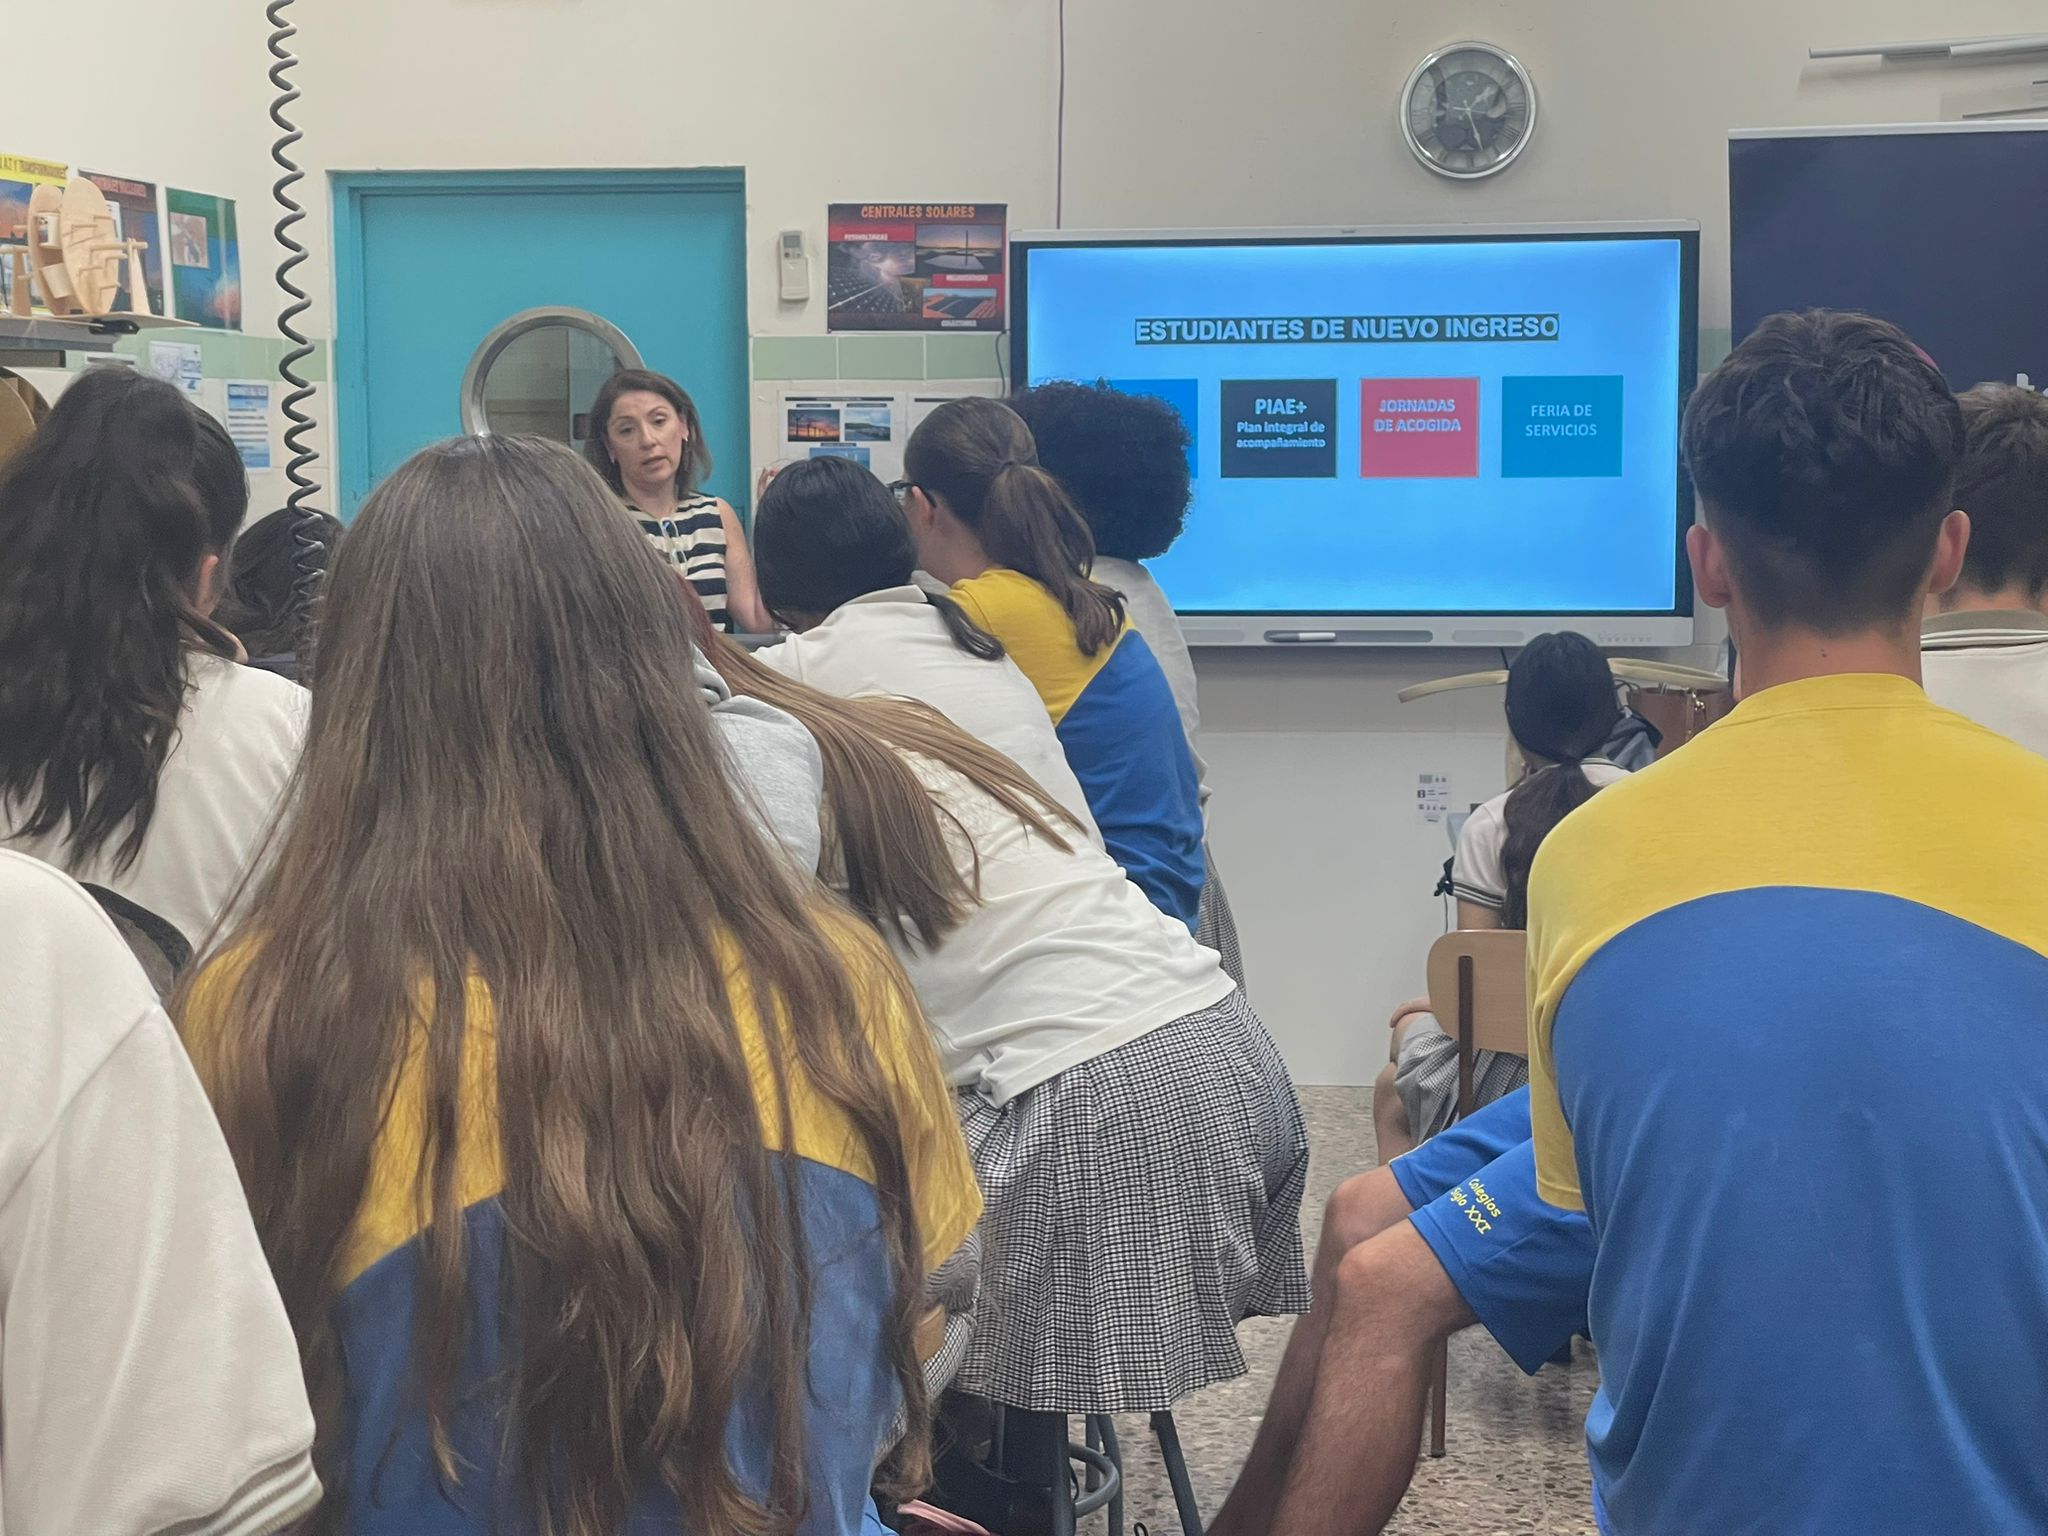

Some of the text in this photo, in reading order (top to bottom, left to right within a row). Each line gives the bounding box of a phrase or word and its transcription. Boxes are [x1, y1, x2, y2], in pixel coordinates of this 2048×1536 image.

[861, 205, 976, 218] CENTRALES SOLARES
[1135, 316, 1559, 341] ESTUDIANTES DE NUEVO INGRESO
[1255, 398, 1307, 415] PIAE+
[1379, 399, 1455, 413] JORNADAS
[1531, 404, 1592, 417] FERIA DE
[1236, 420, 1325, 435] Plan integral de
[1374, 418, 1461, 432] DE ACOGIDA
[1525, 423, 1597, 436] SERVICIOS
[1236, 437, 1326, 449] acompañamiento
[1468, 1178, 1501, 1218] Colegios
[1464, 1204, 1492, 1234] XXI
